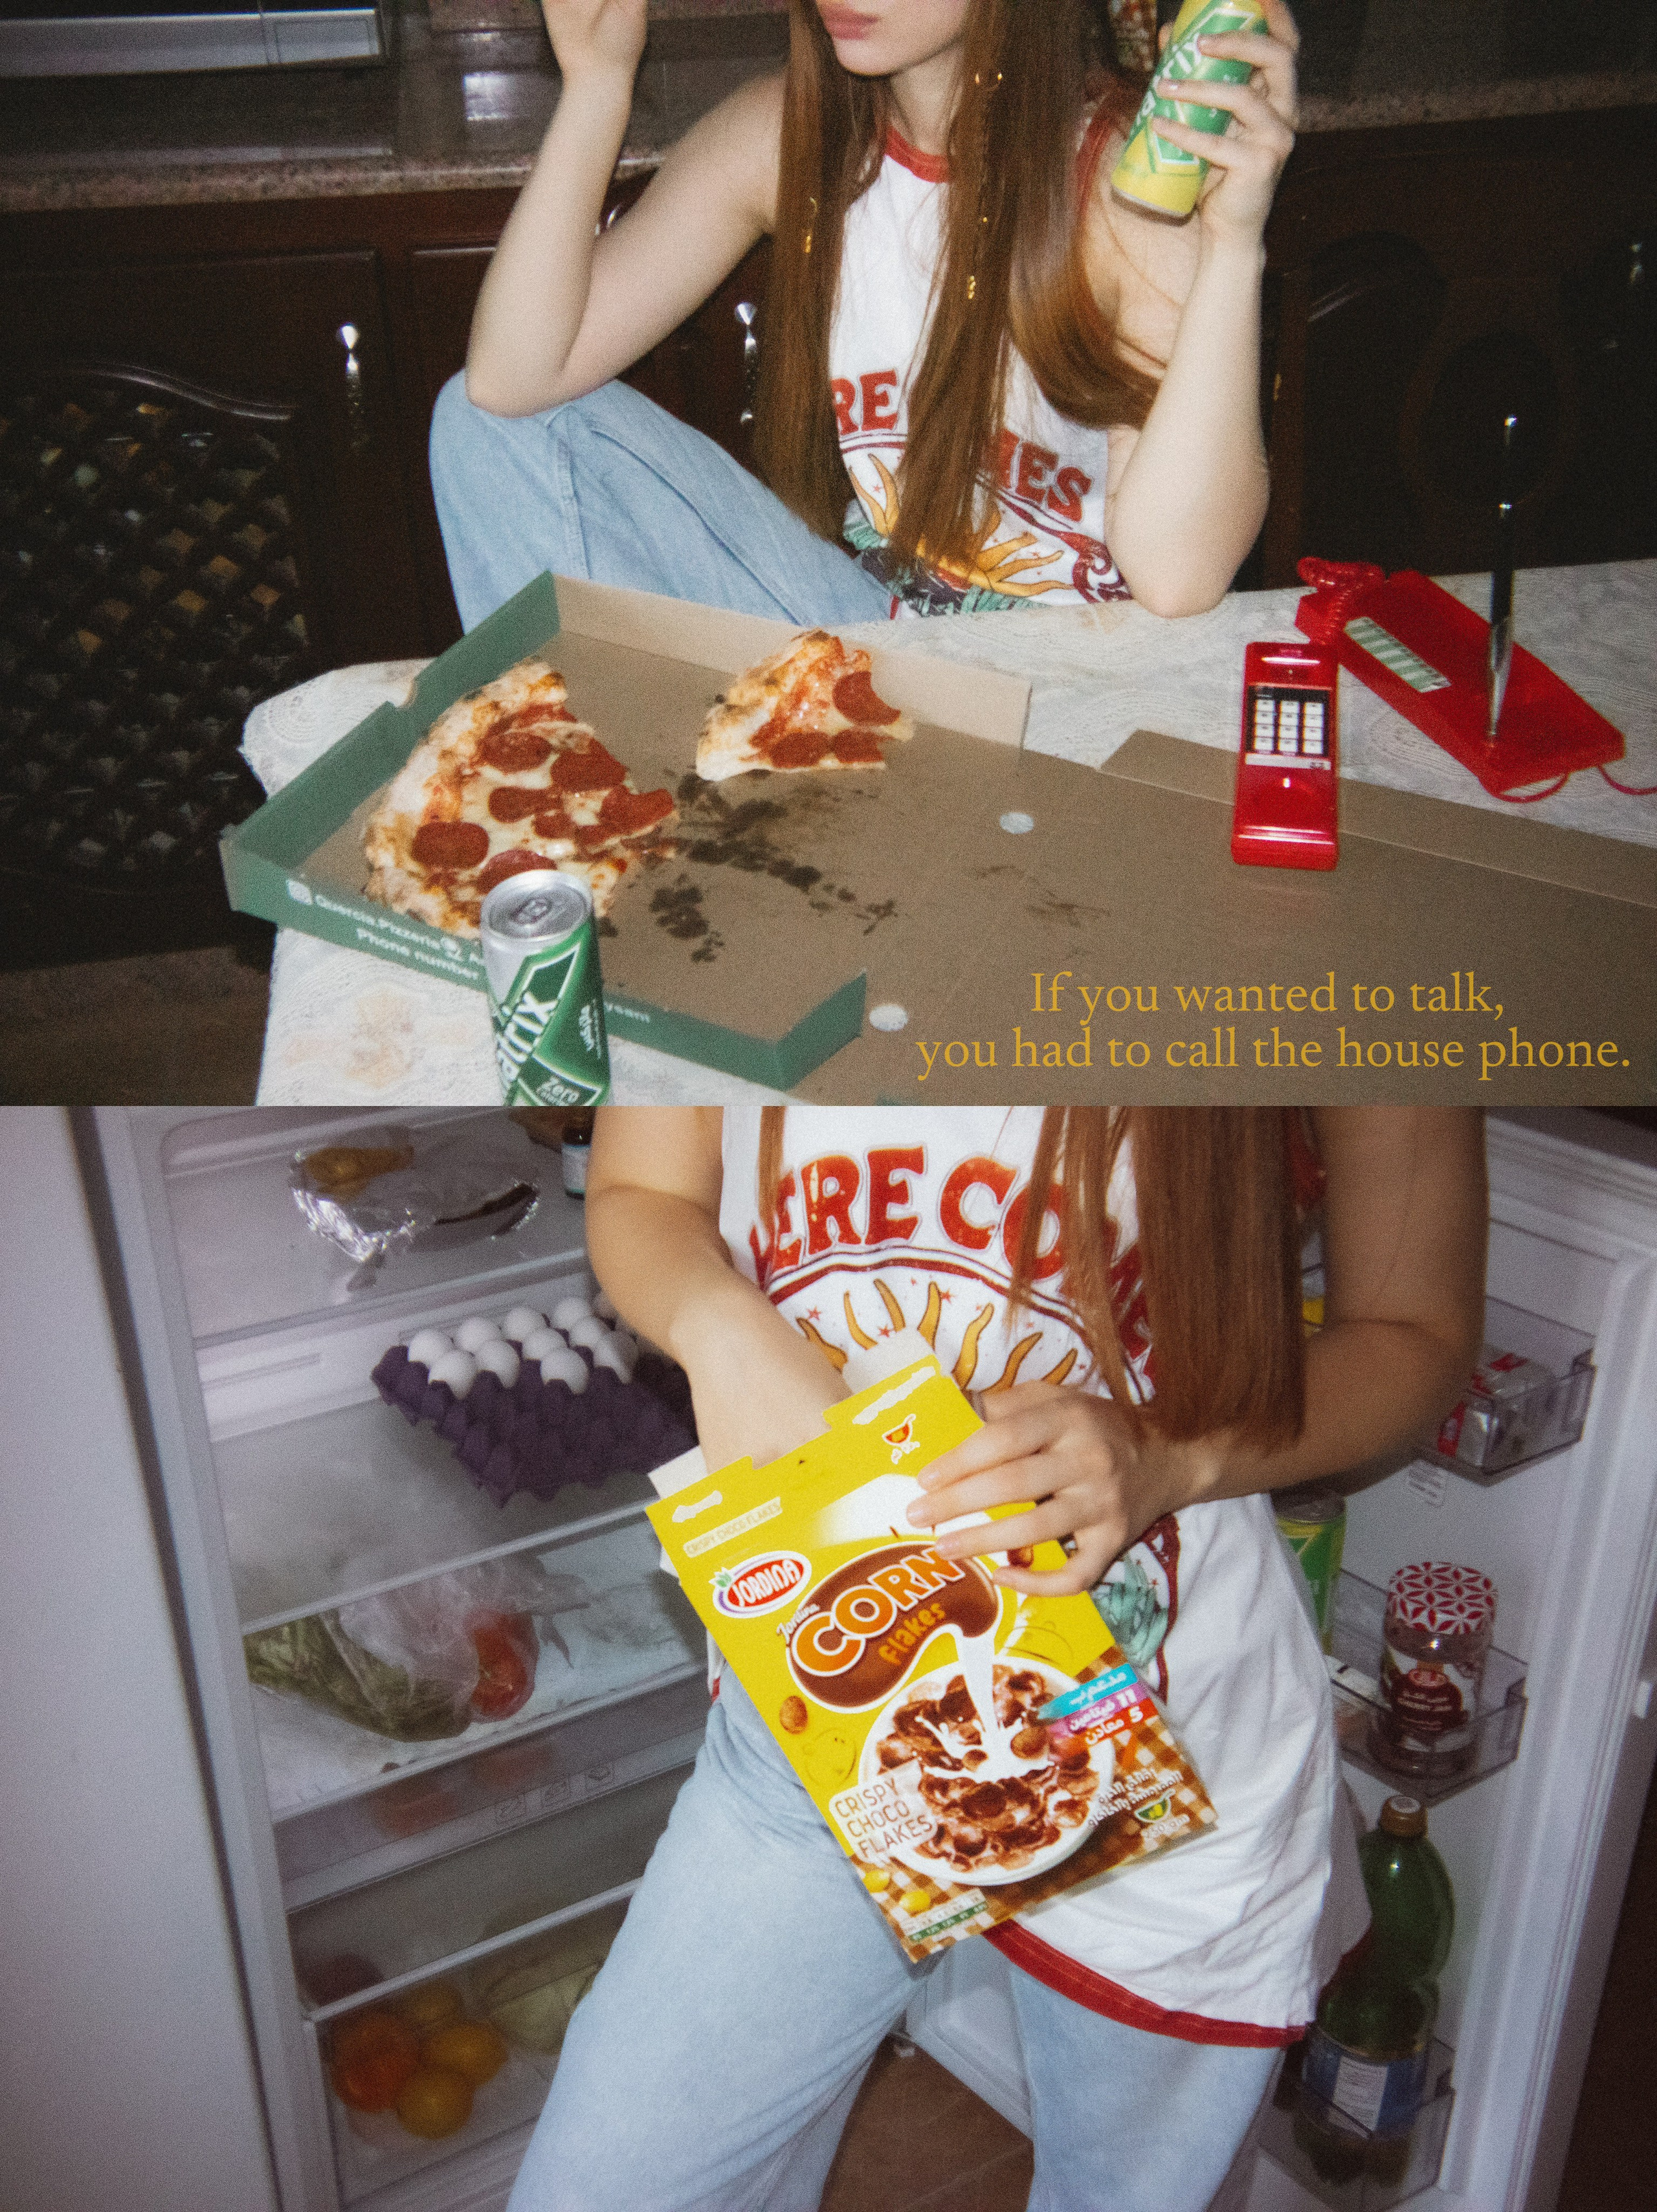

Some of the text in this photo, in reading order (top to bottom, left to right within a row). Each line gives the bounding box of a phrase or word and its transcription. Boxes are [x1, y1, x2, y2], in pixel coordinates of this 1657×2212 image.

[357, 927, 410, 957] Phone
[415, 951, 478, 980] number
[537, 1077, 580, 1103] Zero
[730, 1559, 801, 1607] JORDINA
[790, 1547, 966, 1677] CORN
[1117, 1688, 1137, 1708] 11
[1085, 1705, 1144, 1745] 5 معادن
[834, 1777, 899, 1818] CRISPY
[847, 1799, 911, 1837] CHOCO
[858, 1814, 933, 1858] FLAKES
